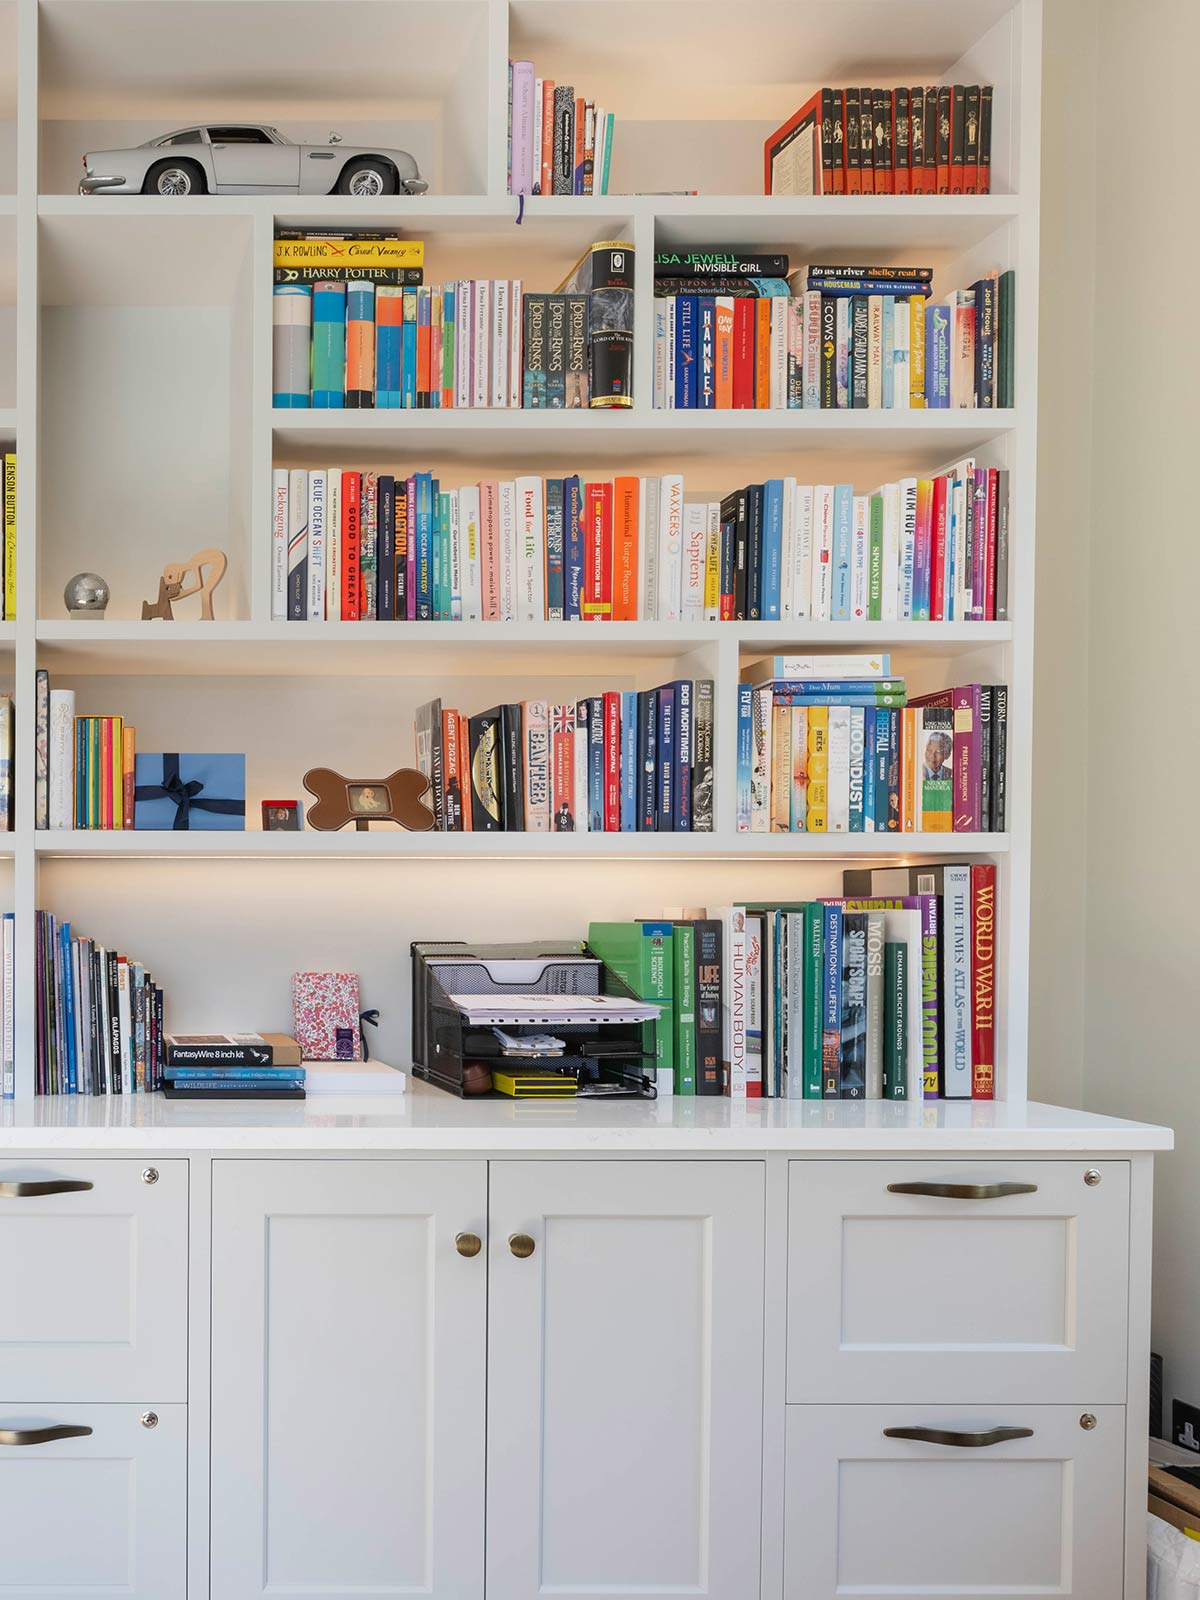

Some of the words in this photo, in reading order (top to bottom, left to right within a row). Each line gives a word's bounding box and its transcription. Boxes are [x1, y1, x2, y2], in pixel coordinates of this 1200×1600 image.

[302, 268, 341, 278] HARRY
[345, 268, 389, 279] POTTER
[654, 254, 680, 264] ISA
[683, 253, 740, 264] JEWELL
[694, 263, 736, 272] INVISIBLE
[739, 263, 761, 272] GIRL
[825, 306, 834, 340] COWS
[6, 462, 15, 491] JENSON
[313, 480, 323, 502] BLUE
[6, 494, 15, 525] BUTTON
[273, 487, 287, 538] Belonging
[525, 491, 534, 518] Food
[624, 491, 632, 537] Humankind
[670, 483, 680, 536] VAXXERS
[906, 487, 916, 511] WIM
[313, 506, 322, 536] OCEAN
[348, 508, 356, 539] GOOD
[395, 495, 406, 555] TRACTION
[525, 521, 533, 533] for
[905, 514, 915, 535] HOF
[313, 540, 322, 567] SHIFT
[348, 547, 355, 560] TO
[525, 536, 535, 558] Life
[621, 542, 631, 568] Rutger
[687, 532, 704, 587] Sapiens
[621, 570, 631, 604] Bregman
[680, 685, 690, 705] BOB
[997, 691, 1006, 722] STORM
[680, 708, 690, 763] MORTIMER
[877, 712, 889, 753] FREEFALL
[528, 730, 548, 805] BANTER
[850, 715, 863, 812] MOONDUST
[954, 893, 964, 920] THE
[976, 886, 993, 961] WORLD
[829, 914, 838, 975] DESTINATIONS
[868, 921, 882, 976] MOSS
[954, 923, 964, 964] TIMES
[733, 944, 743, 1016] HUMAN
[848, 930, 865, 1007] SPORTSCAPE
[954, 968, 965, 1008] ATLAS
[976, 966, 992, 1011] WAR
[829, 989, 837, 1023] LIFETIME
[976, 1015, 992, 1030] II
[112, 1017, 120, 1054] GALÁPAGOS
[734, 1020, 744, 1070] BODY
[955, 1030, 965, 1071] WORLD
[173, 1050, 214, 1059] FantasyWire
[221, 1050, 235, 1058] inch
[236, 1050, 244, 1058] kit
